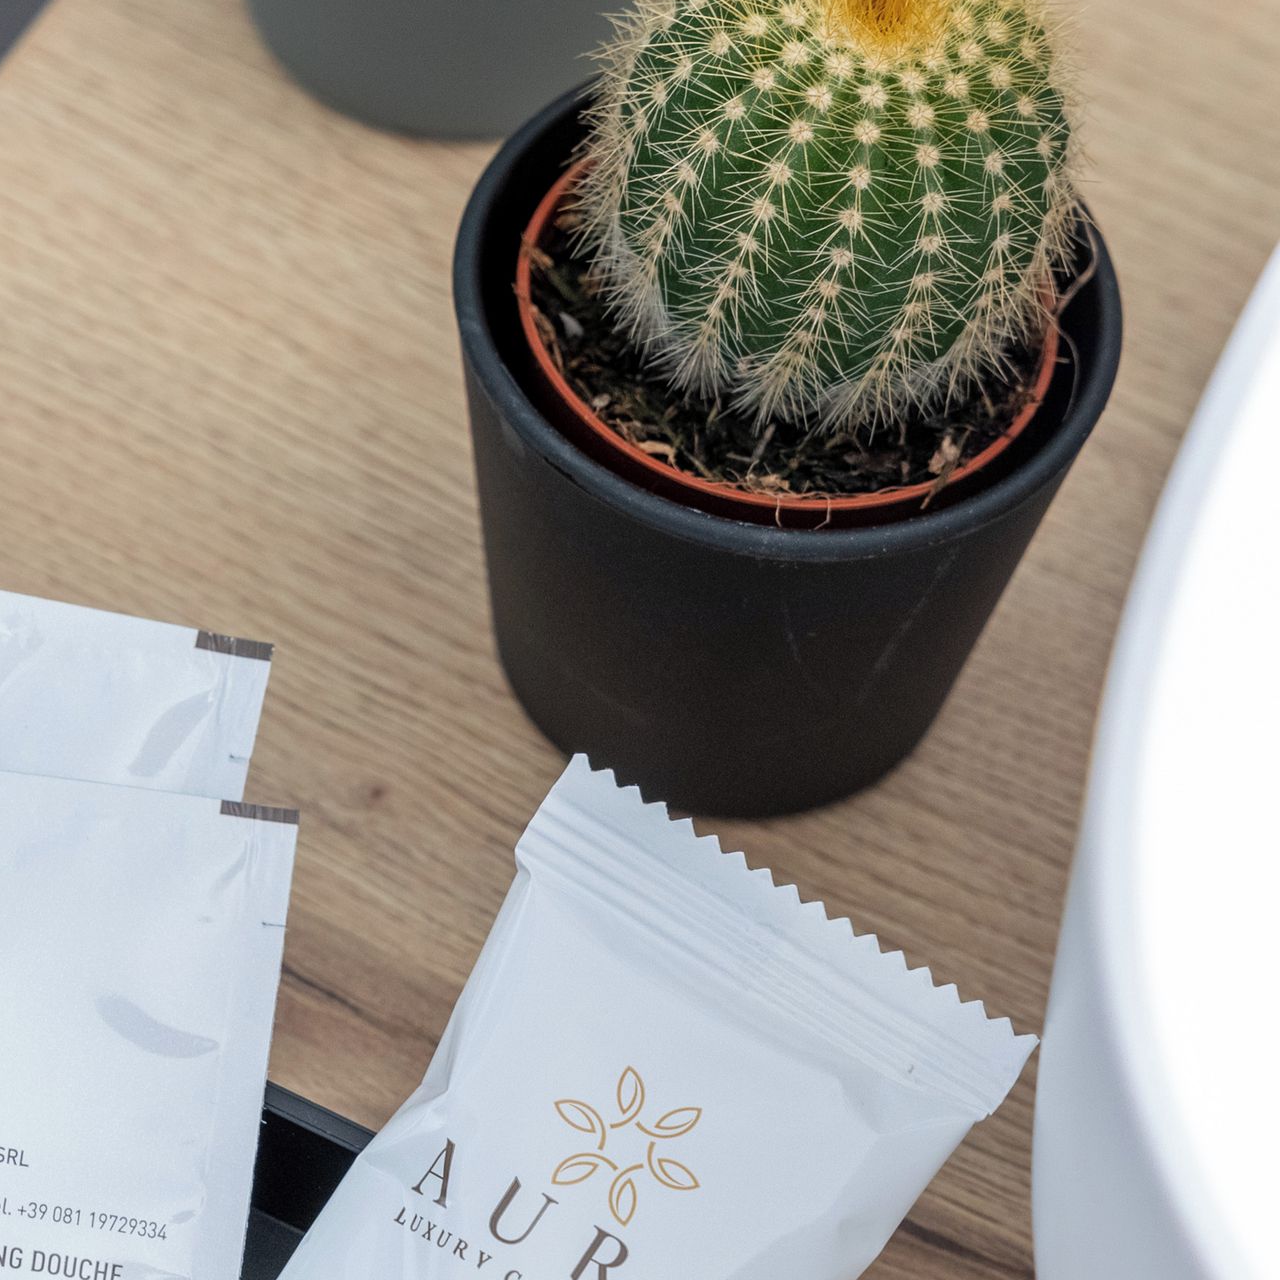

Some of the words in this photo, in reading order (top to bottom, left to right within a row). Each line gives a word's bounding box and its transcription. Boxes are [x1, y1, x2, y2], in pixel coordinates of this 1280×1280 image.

[17, 1201, 48, 1221] +39
[52, 1205, 82, 1226] 081
[89, 1211, 168, 1241] 19729334
[393, 1206, 493, 1270] LUXURY
